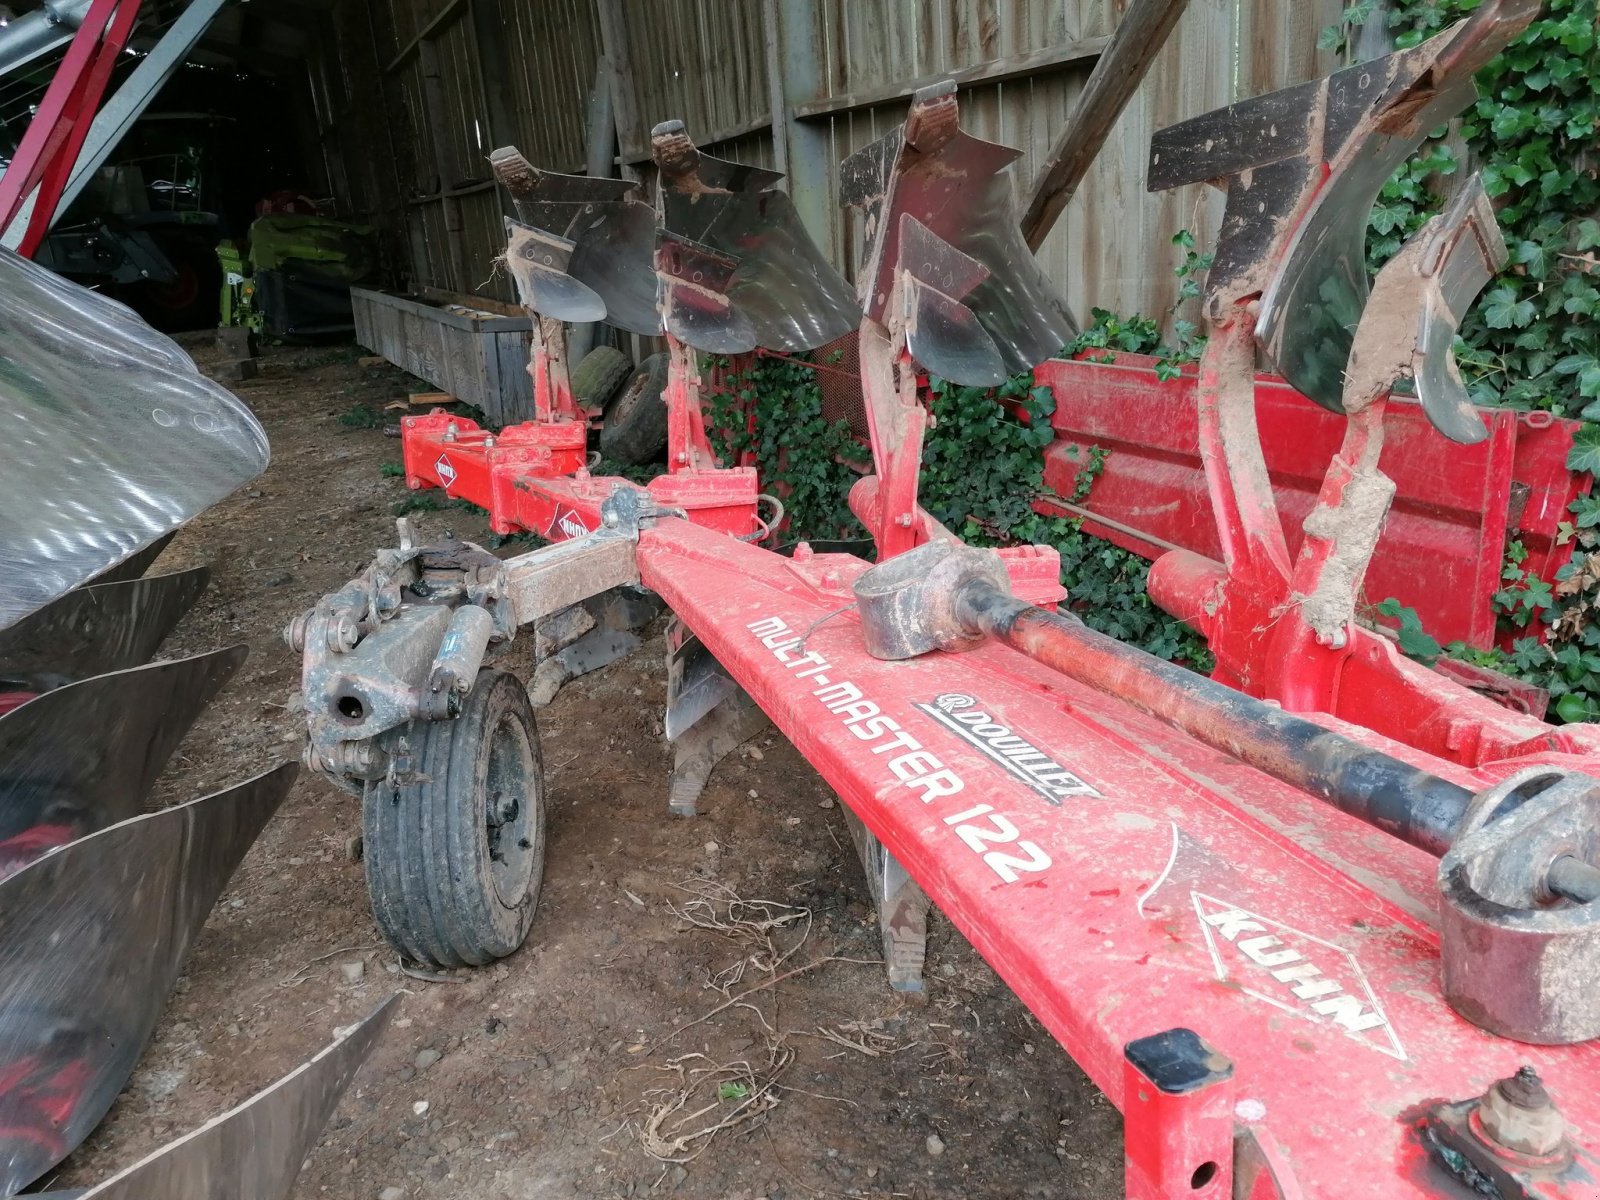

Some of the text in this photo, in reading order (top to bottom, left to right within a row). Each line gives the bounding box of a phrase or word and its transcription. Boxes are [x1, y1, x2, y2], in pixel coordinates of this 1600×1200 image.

[437, 462, 454, 479] KUHN
[746, 616, 1053, 884] MULTI-MASTER 122
[950, 710, 1107, 798] DOUILLET
[1201, 908, 1388, 1033] KUHN
